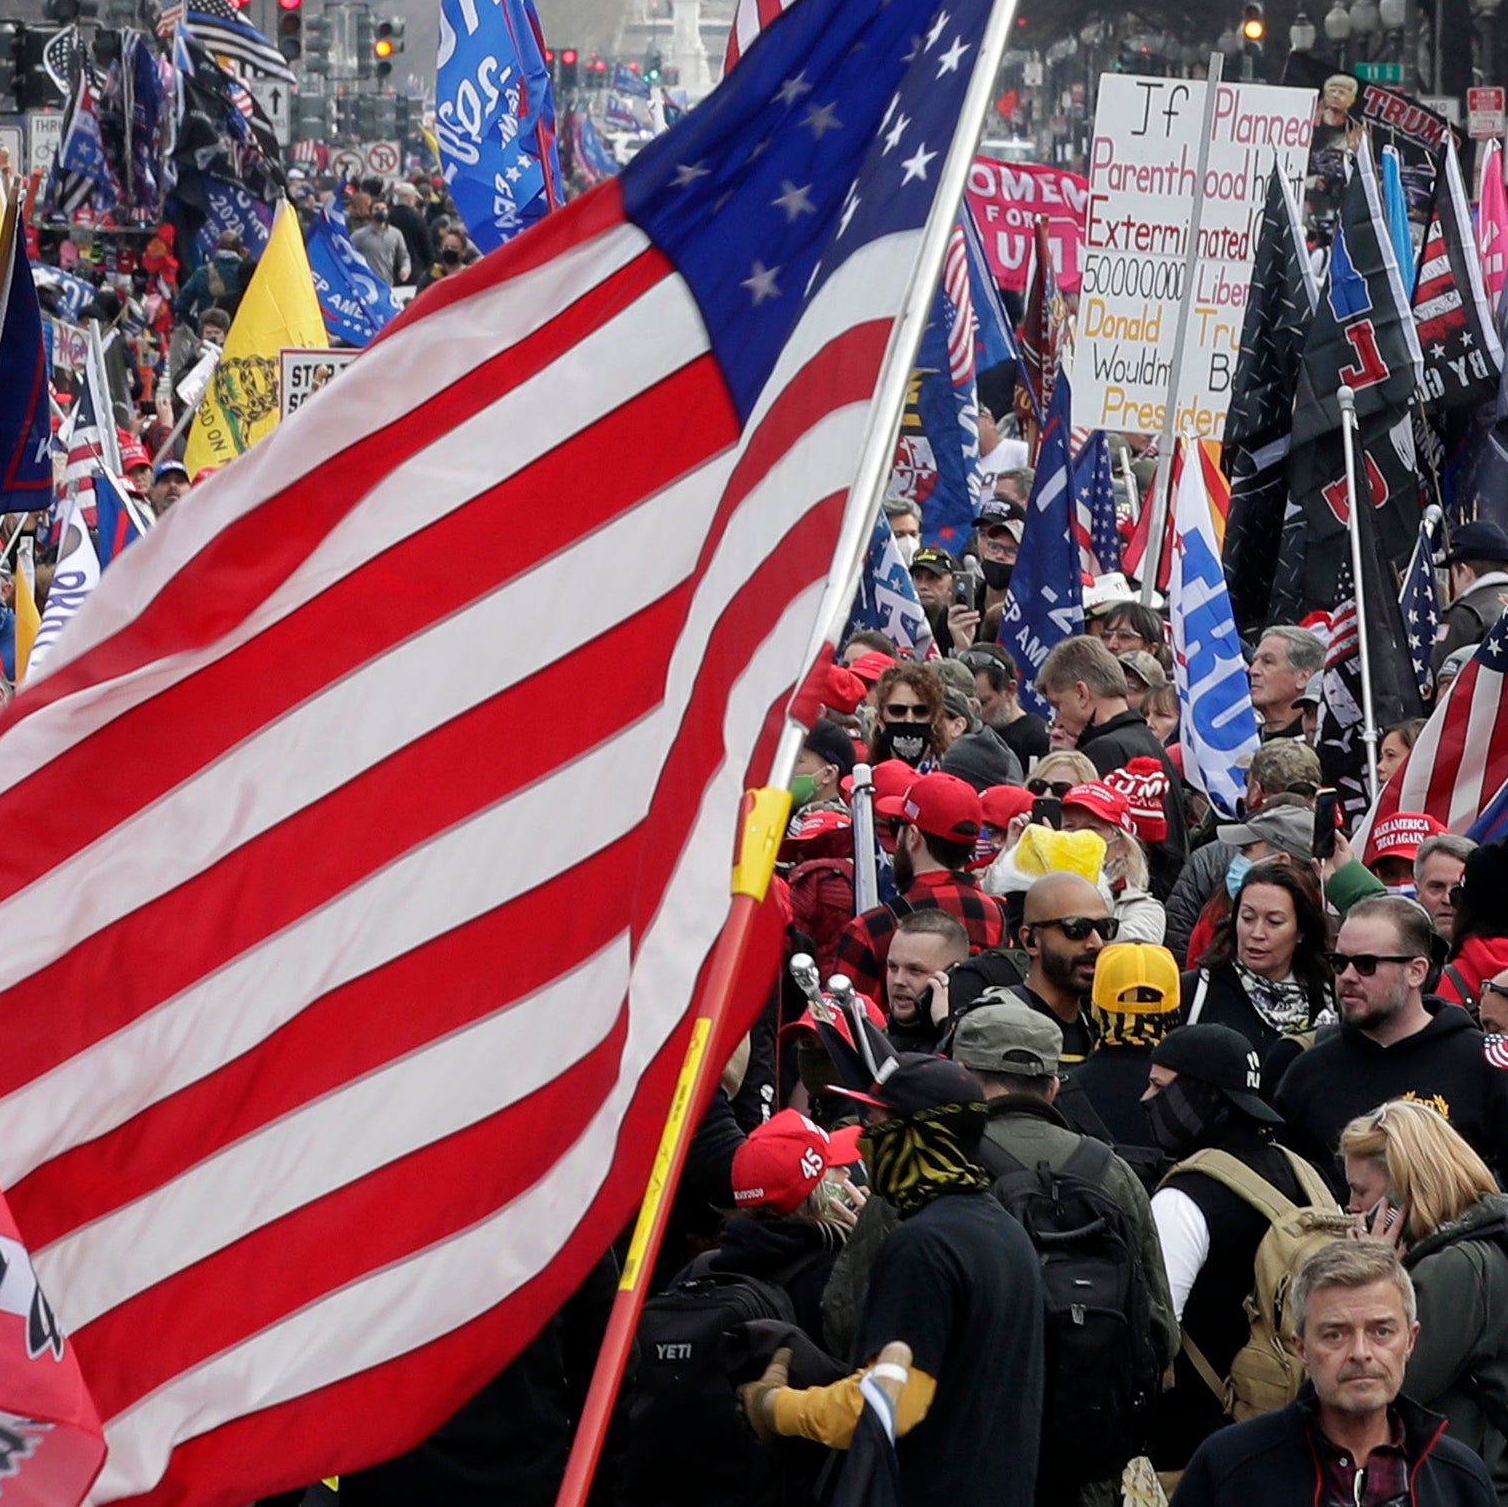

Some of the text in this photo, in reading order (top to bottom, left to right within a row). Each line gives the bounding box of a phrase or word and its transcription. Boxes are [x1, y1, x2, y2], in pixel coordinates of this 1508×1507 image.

[1212, 86, 1317, 148] Planned
[967, 163, 1089, 214] OMEN
[986, 204, 1038, 230] FOR
[1087, 194, 1254, 262] Exterminated
[1084, 298, 1163, 344] Donald
[206, 431, 228, 453] ON
[1389, 818, 1430, 832] AMERICA
[1395, 831, 1424, 845] AGAIN
[800, 1146, 824, 1181] 45
[656, 1342, 693, 1361] YETI
